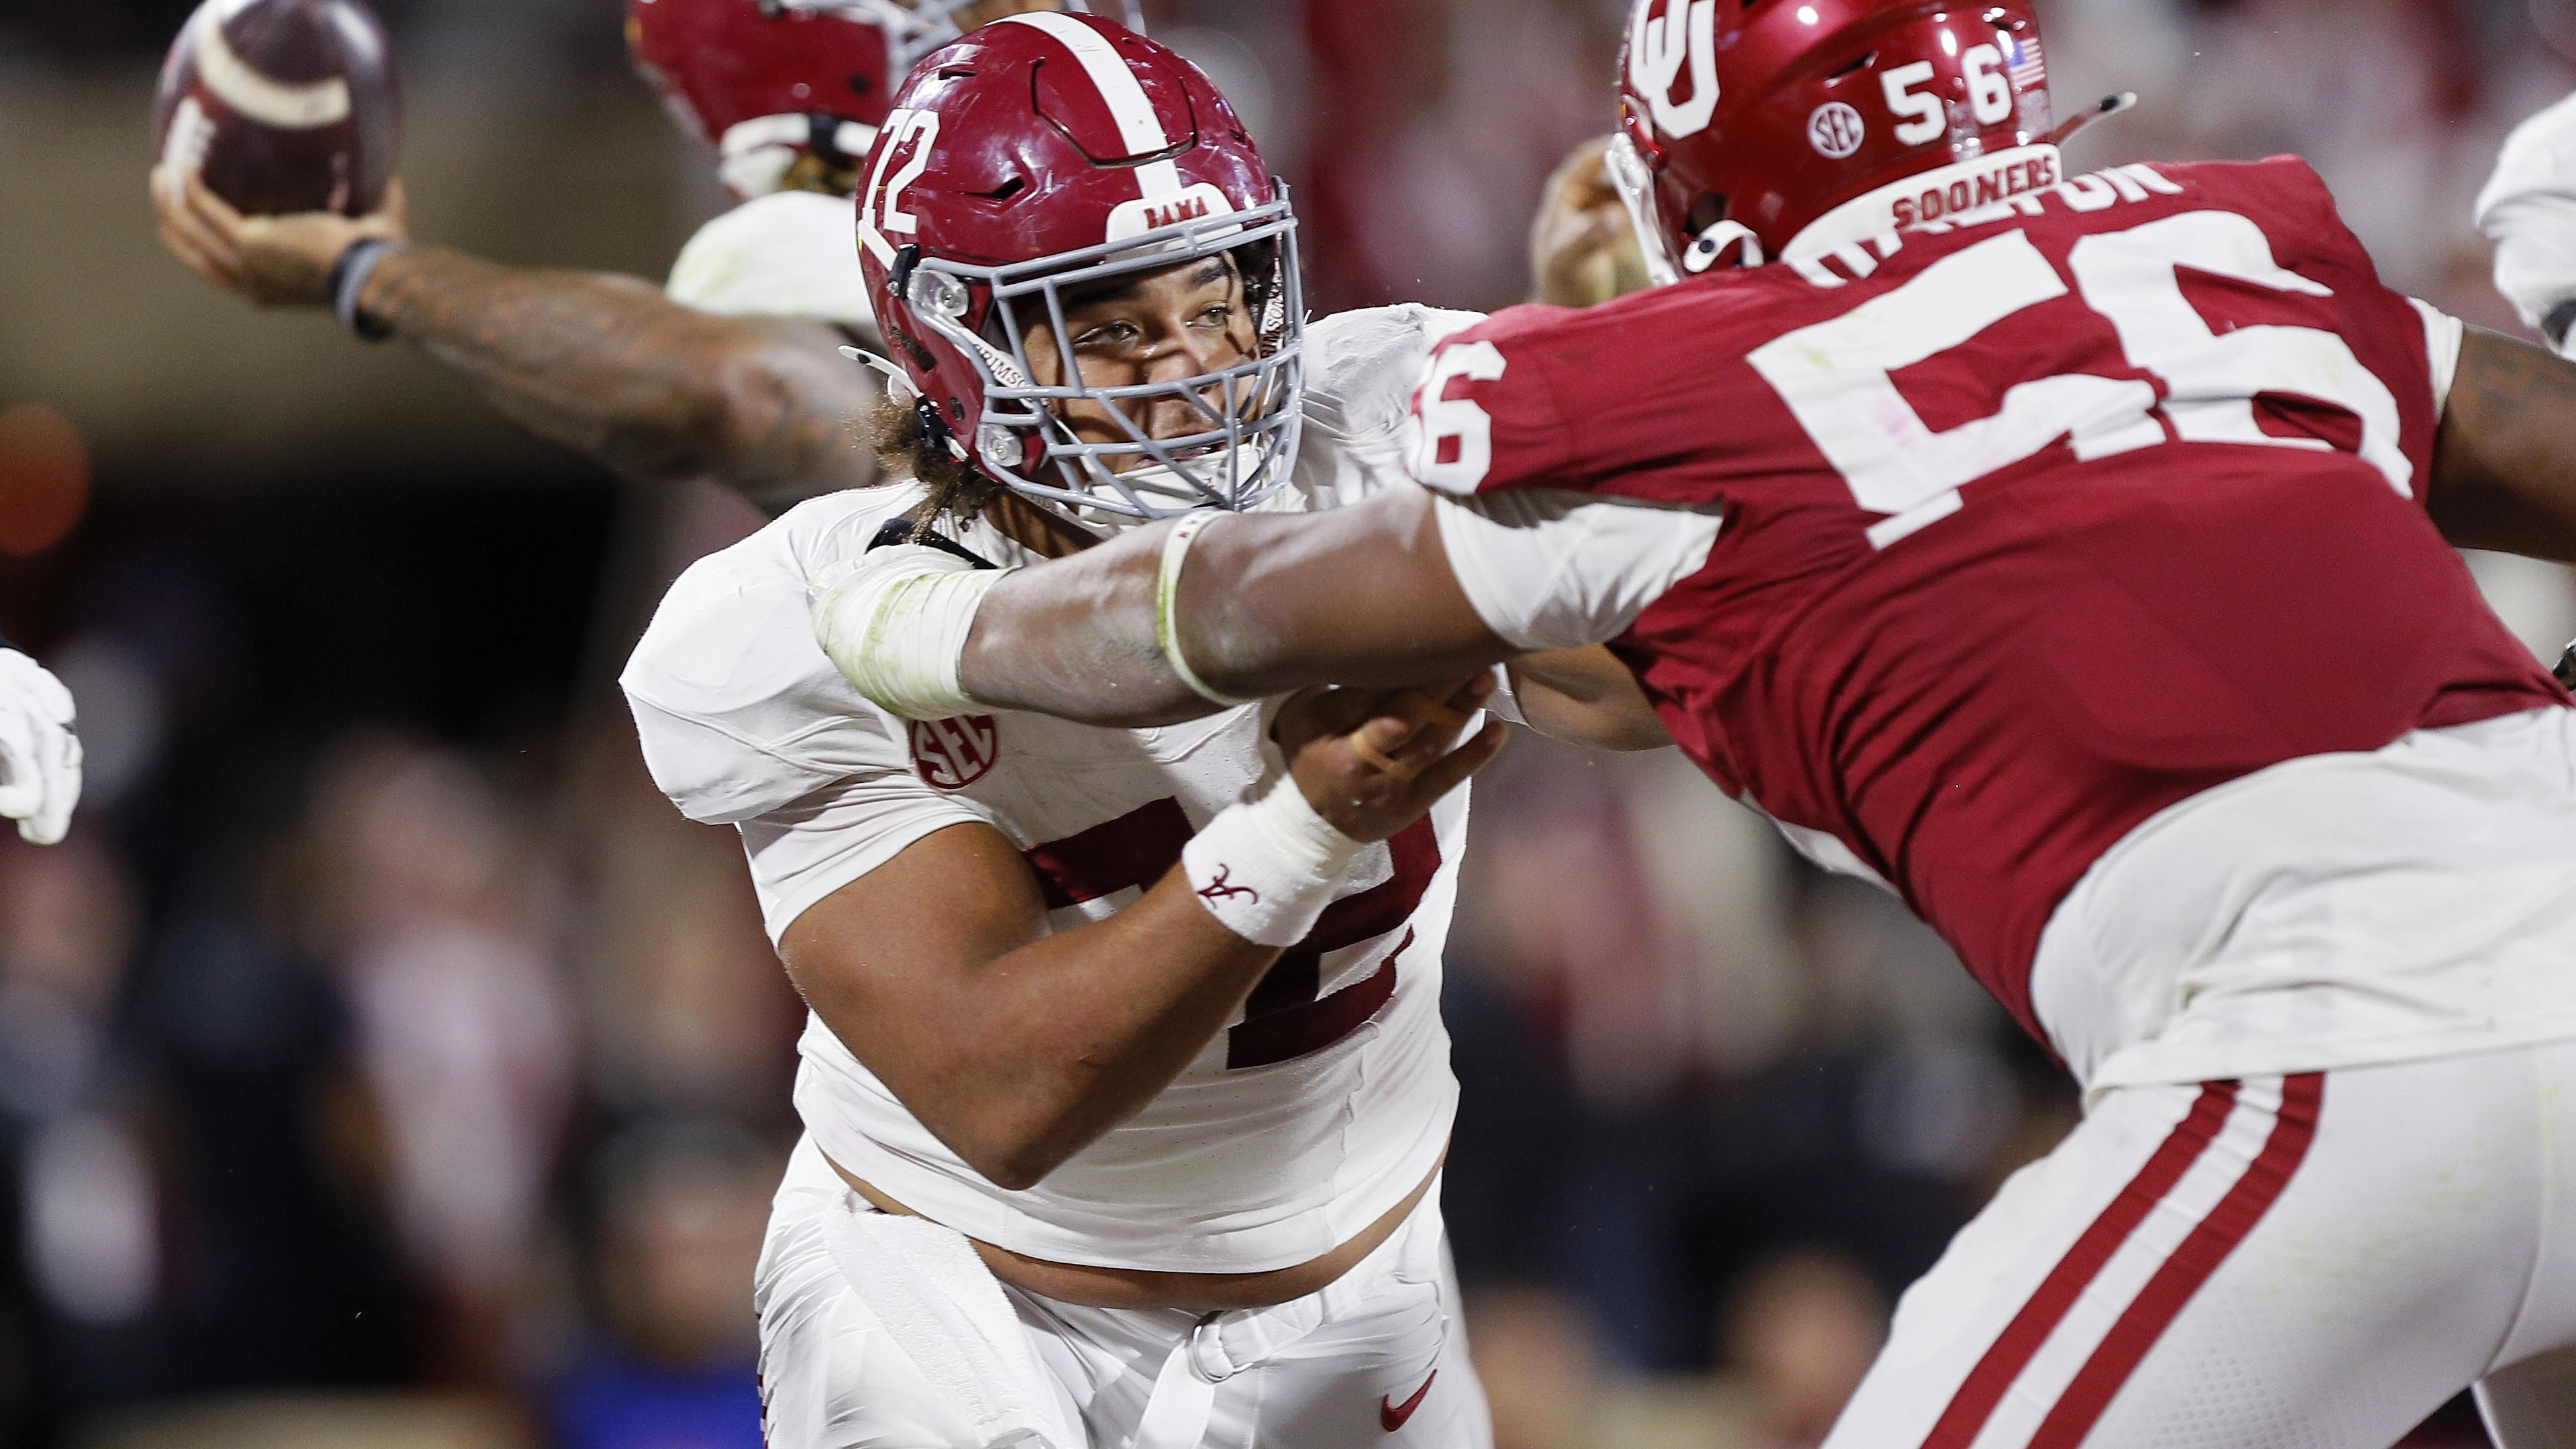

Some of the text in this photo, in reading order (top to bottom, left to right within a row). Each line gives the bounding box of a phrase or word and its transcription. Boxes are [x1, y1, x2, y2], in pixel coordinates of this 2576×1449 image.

[1810, 104, 1863, 157] SEC
[1880, 42, 2012, 147] 56
[861, 108, 941, 235] 72
[1144, 195, 1210, 229] BAMA
[1892, 154, 2054, 229] SOONERS
[1407, 339, 1507, 496] 6
[1746, 209, 2414, 551] 56
